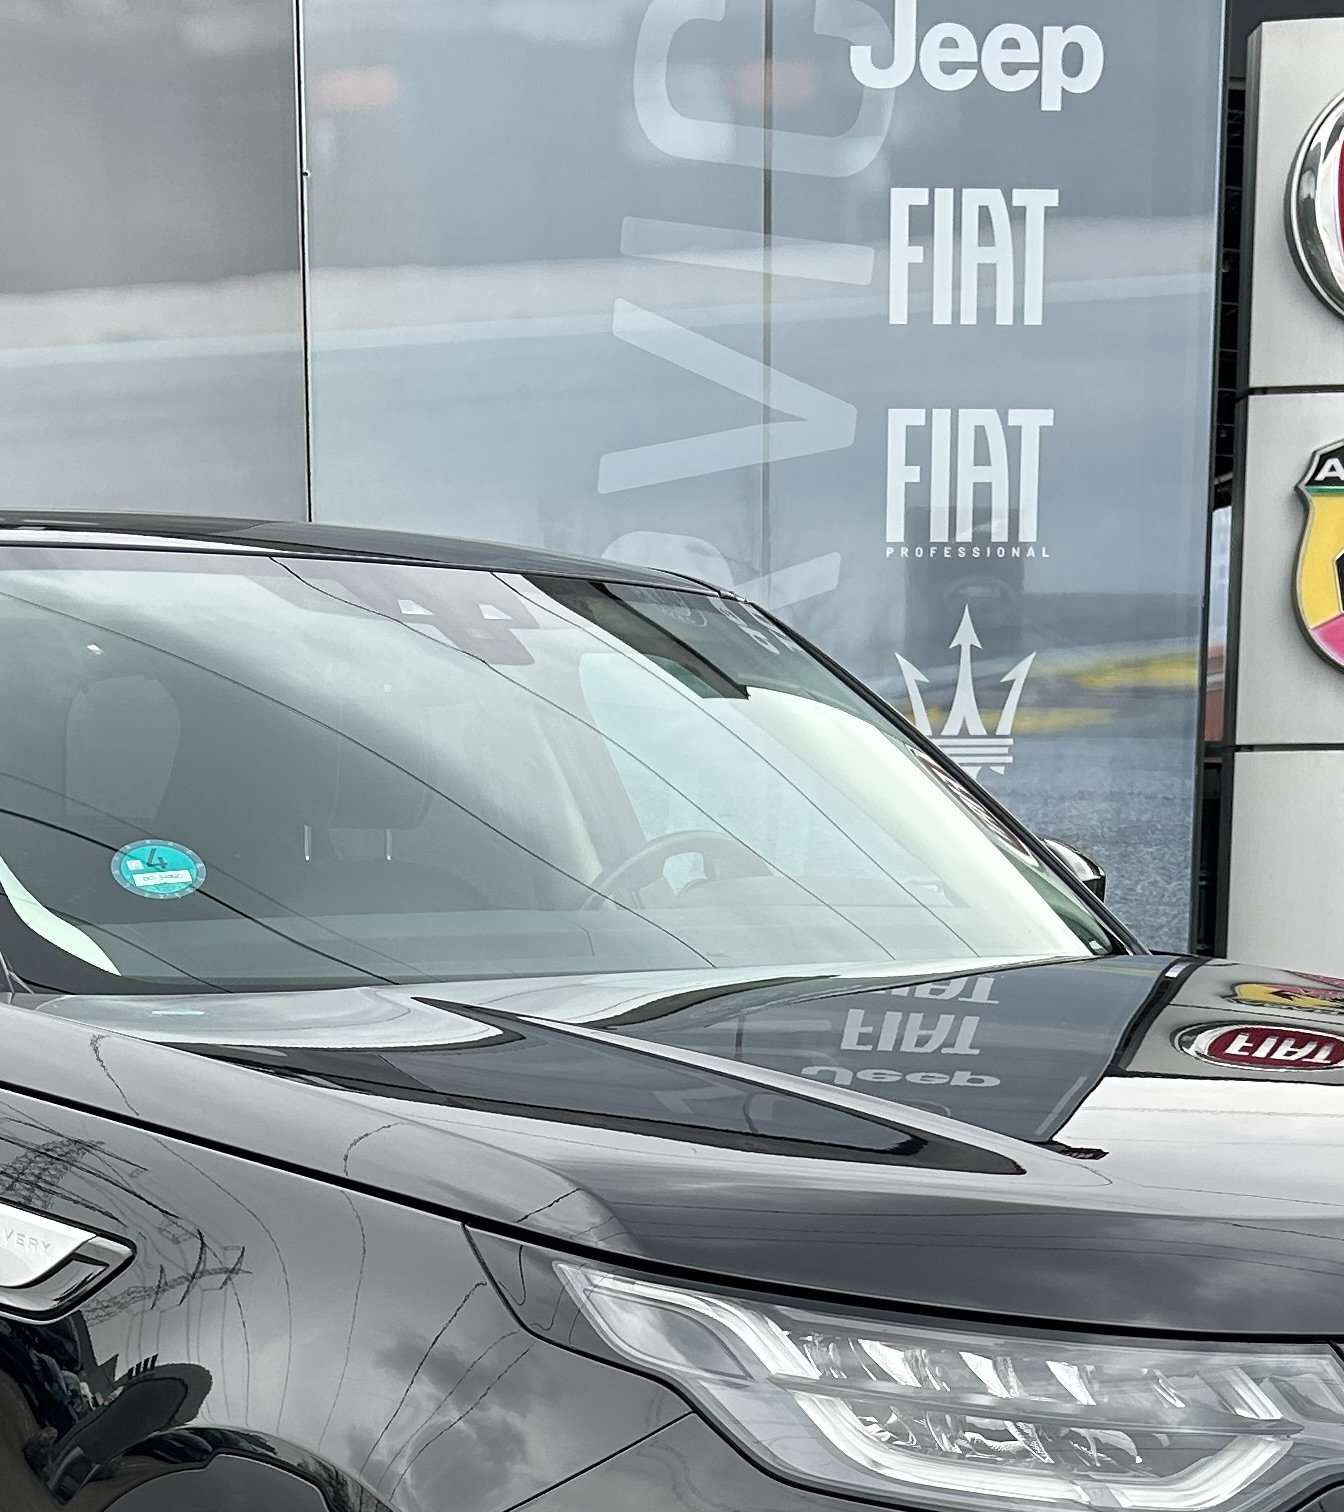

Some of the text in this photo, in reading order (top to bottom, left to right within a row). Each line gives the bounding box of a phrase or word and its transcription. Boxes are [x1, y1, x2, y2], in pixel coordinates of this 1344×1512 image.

[849, 0, 1105, 112] Jeep
[888, 187, 1060, 326] FIAT
[885, 407, 1054, 543] FIAT
[885, 546, 1052, 559] PROFESSIONAL
[146, 847, 168, 869] 4
